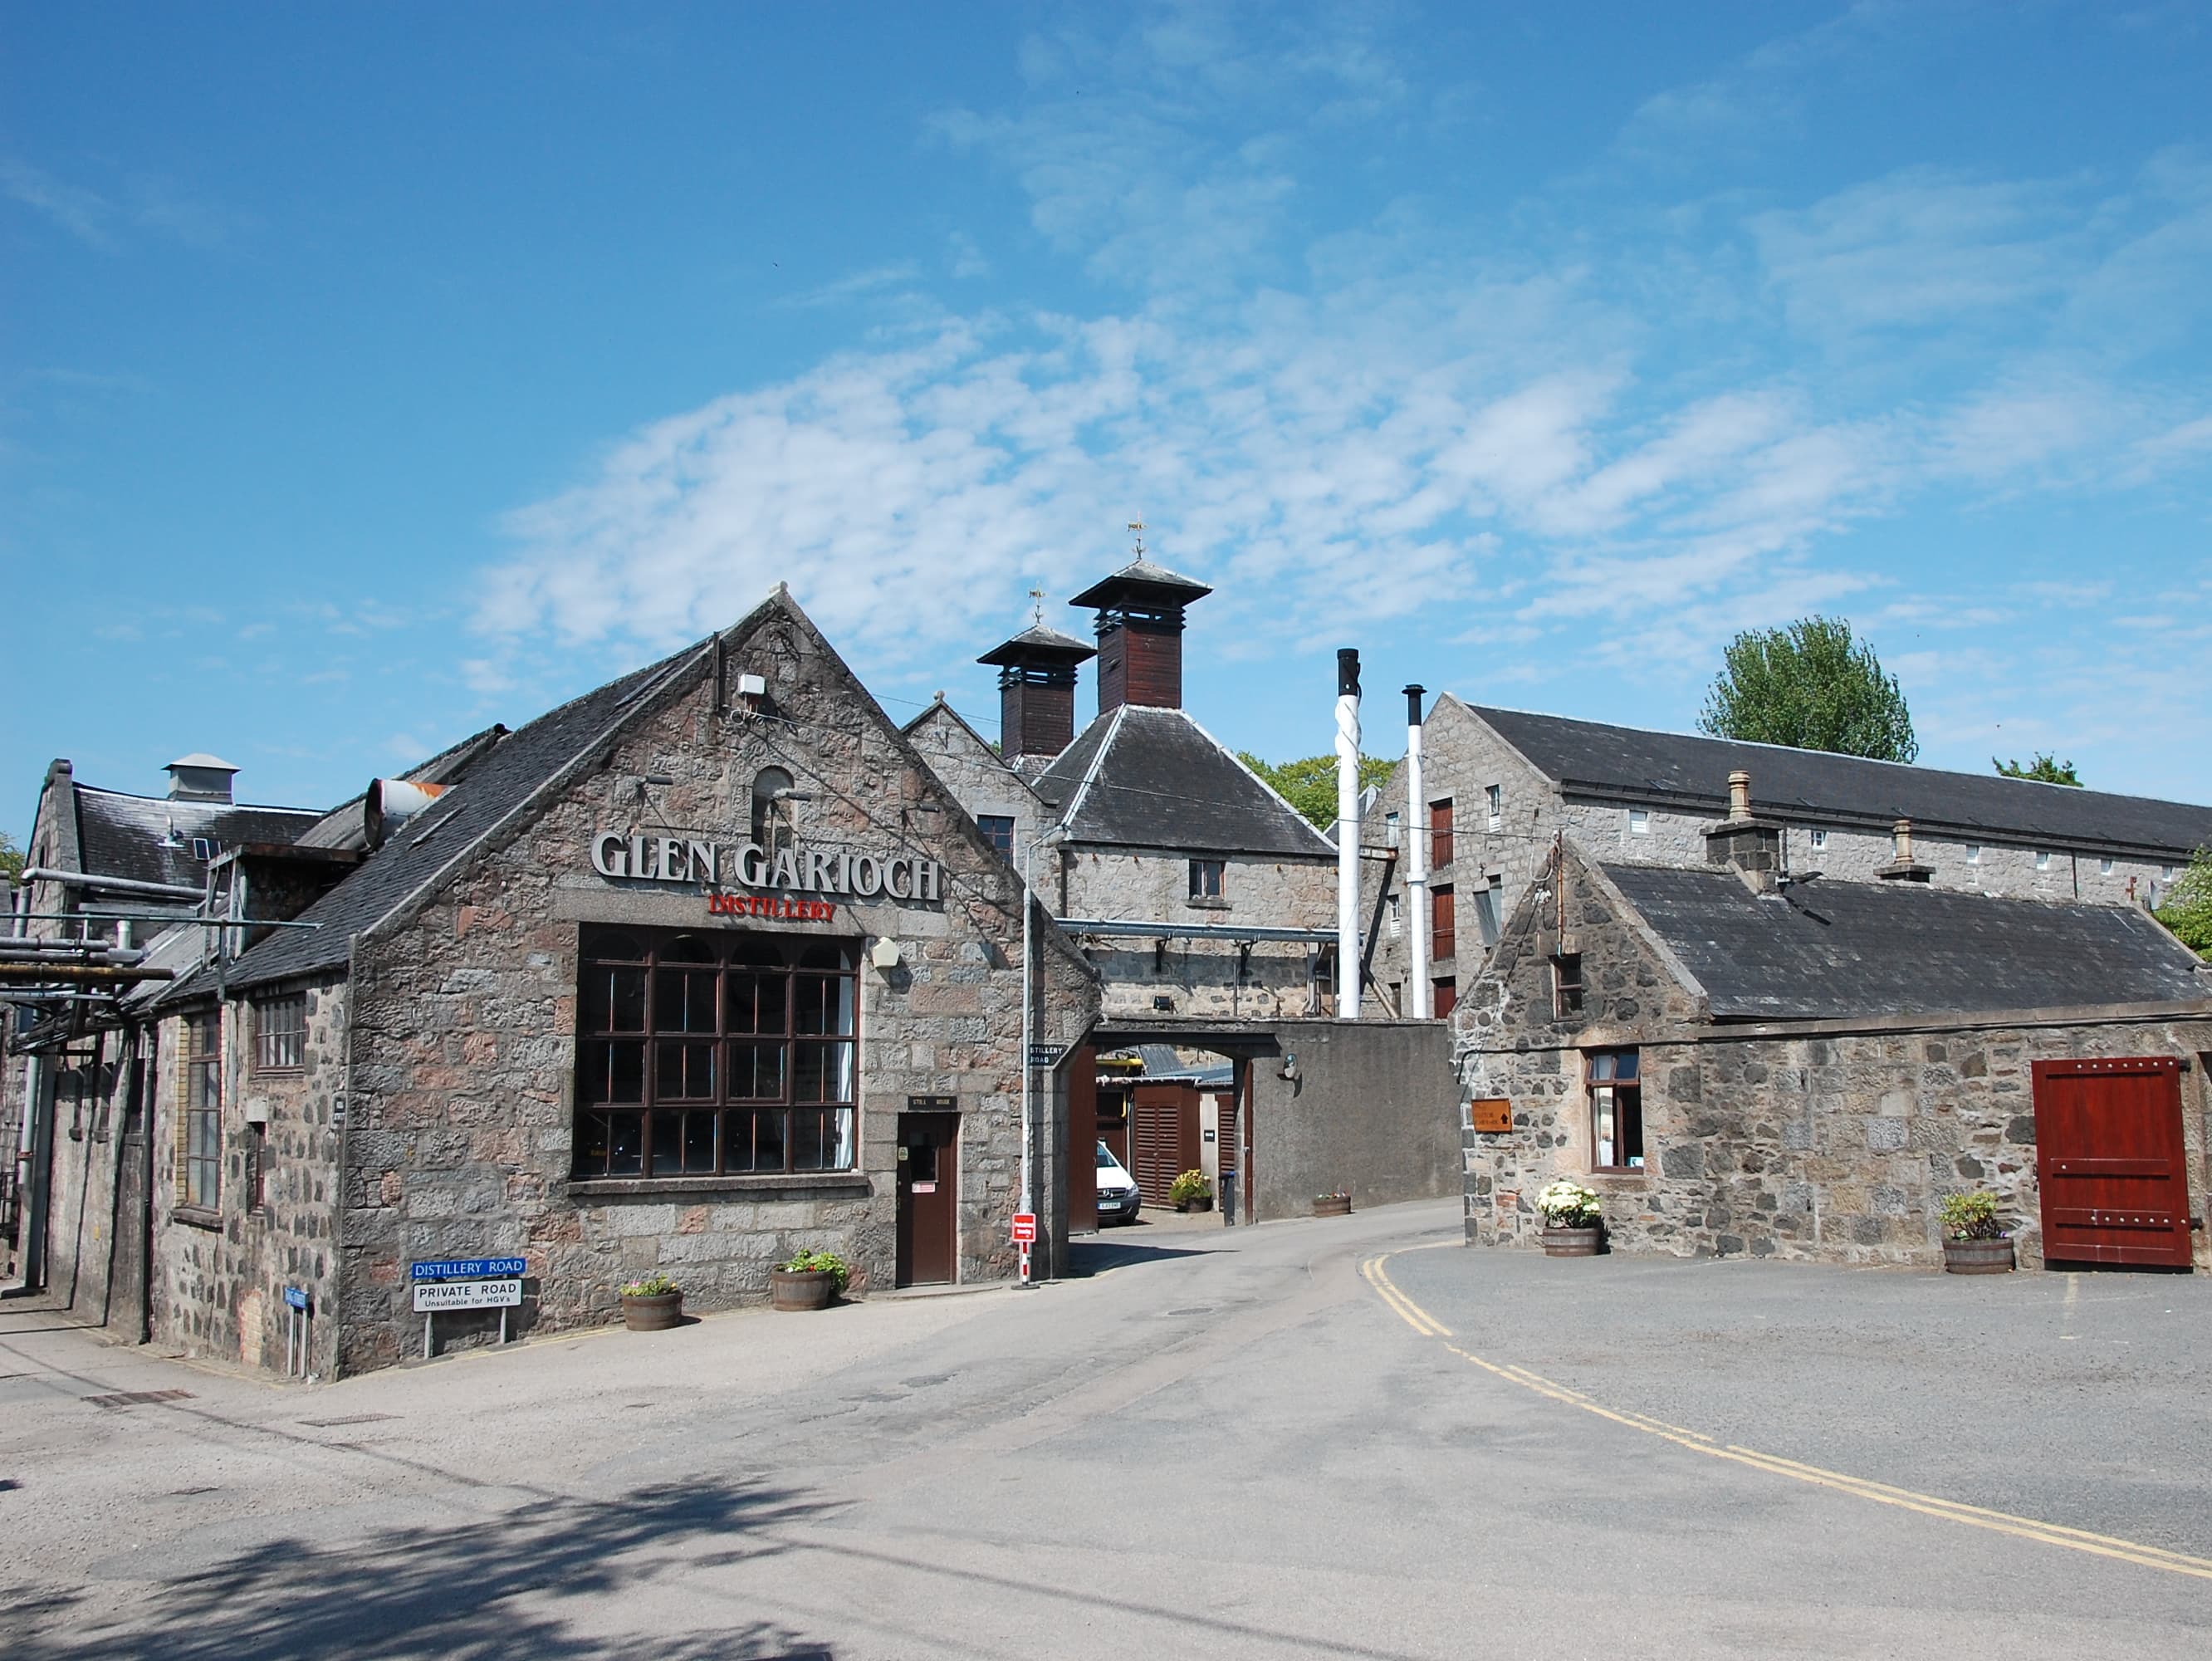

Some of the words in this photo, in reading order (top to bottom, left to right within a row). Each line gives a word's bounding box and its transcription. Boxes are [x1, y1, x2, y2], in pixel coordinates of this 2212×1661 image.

[591, 830, 718, 884] GLEN
[734, 843, 939, 901] GARIOCH
[708, 894, 837, 921] DISTILLERY
[1030, 1046, 1063, 1055] STILLERY
[415, 1263, 482, 1276] DISTILLERY
[488, 1260, 522, 1273] ROAD
[419, 1286, 472, 1298] PRIVATE
[481, 1283, 516, 1295] ROAD
[424, 1297, 467, 1307] Unsuitable
[487, 1296, 511, 1304] HGV's
